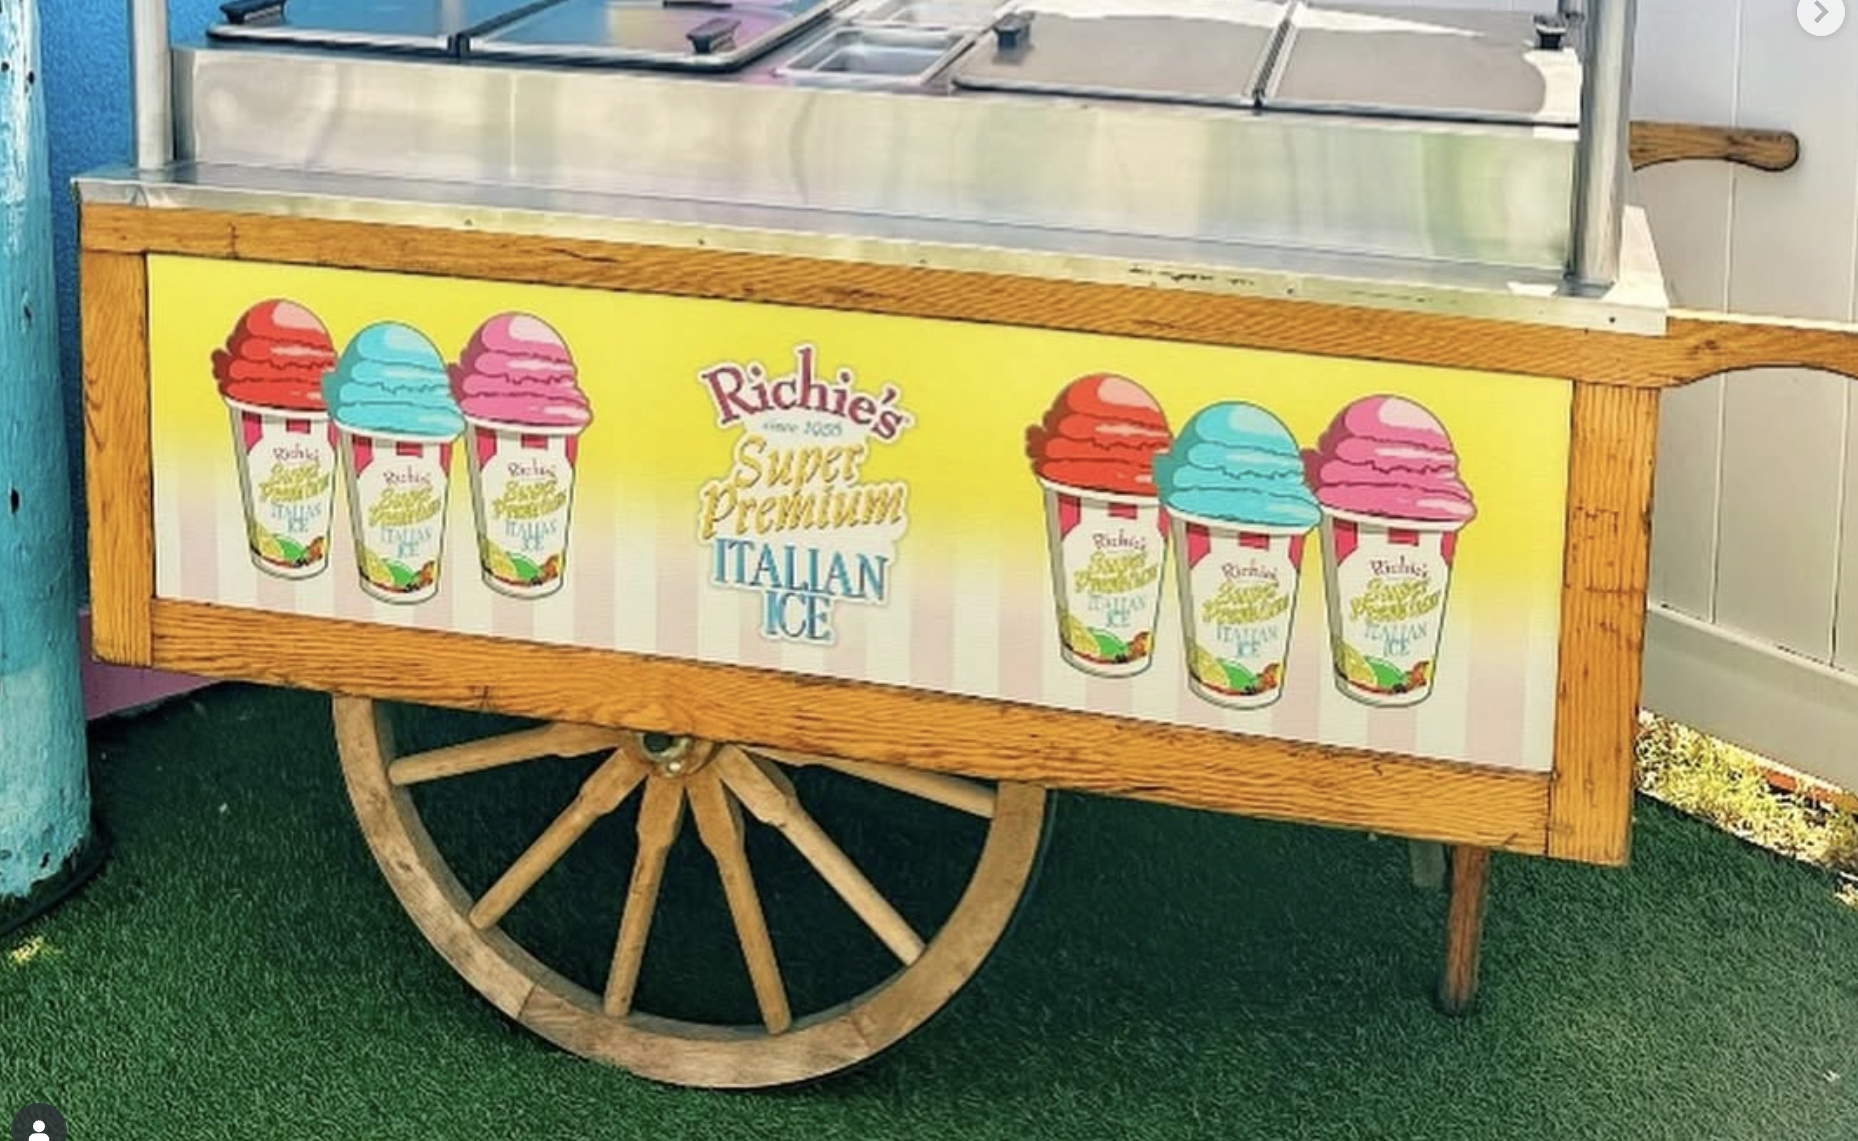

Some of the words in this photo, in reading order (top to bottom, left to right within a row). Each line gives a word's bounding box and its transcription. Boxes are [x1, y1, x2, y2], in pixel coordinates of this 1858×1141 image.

[701, 346, 904, 440] Richie's
[735, 436, 865, 489] Super
[700, 482, 905, 541] Premium
[713, 537, 890, 602] ITALIAN
[764, 589, 832, 642] ICE
